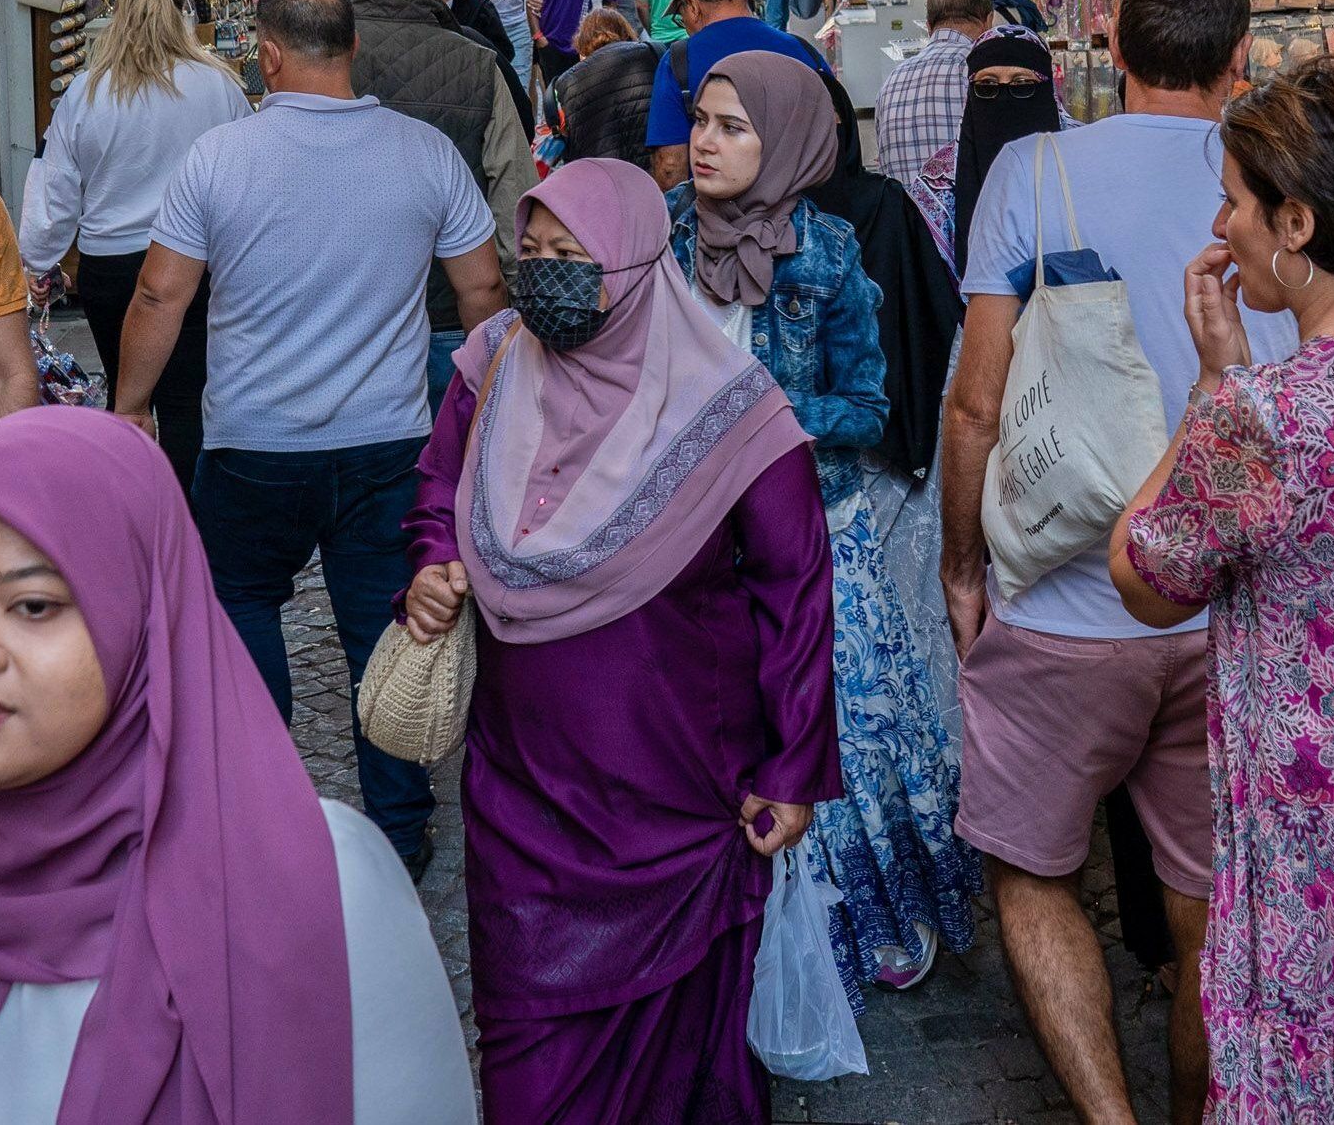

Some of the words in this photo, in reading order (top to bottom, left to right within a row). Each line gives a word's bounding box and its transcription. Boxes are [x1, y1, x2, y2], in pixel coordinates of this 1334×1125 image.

[1014, 369, 1053, 428] COPIÉ
[1018, 425, 1066, 486] ÉGALÉ
[1024, 500, 1065, 538] Tupperware
